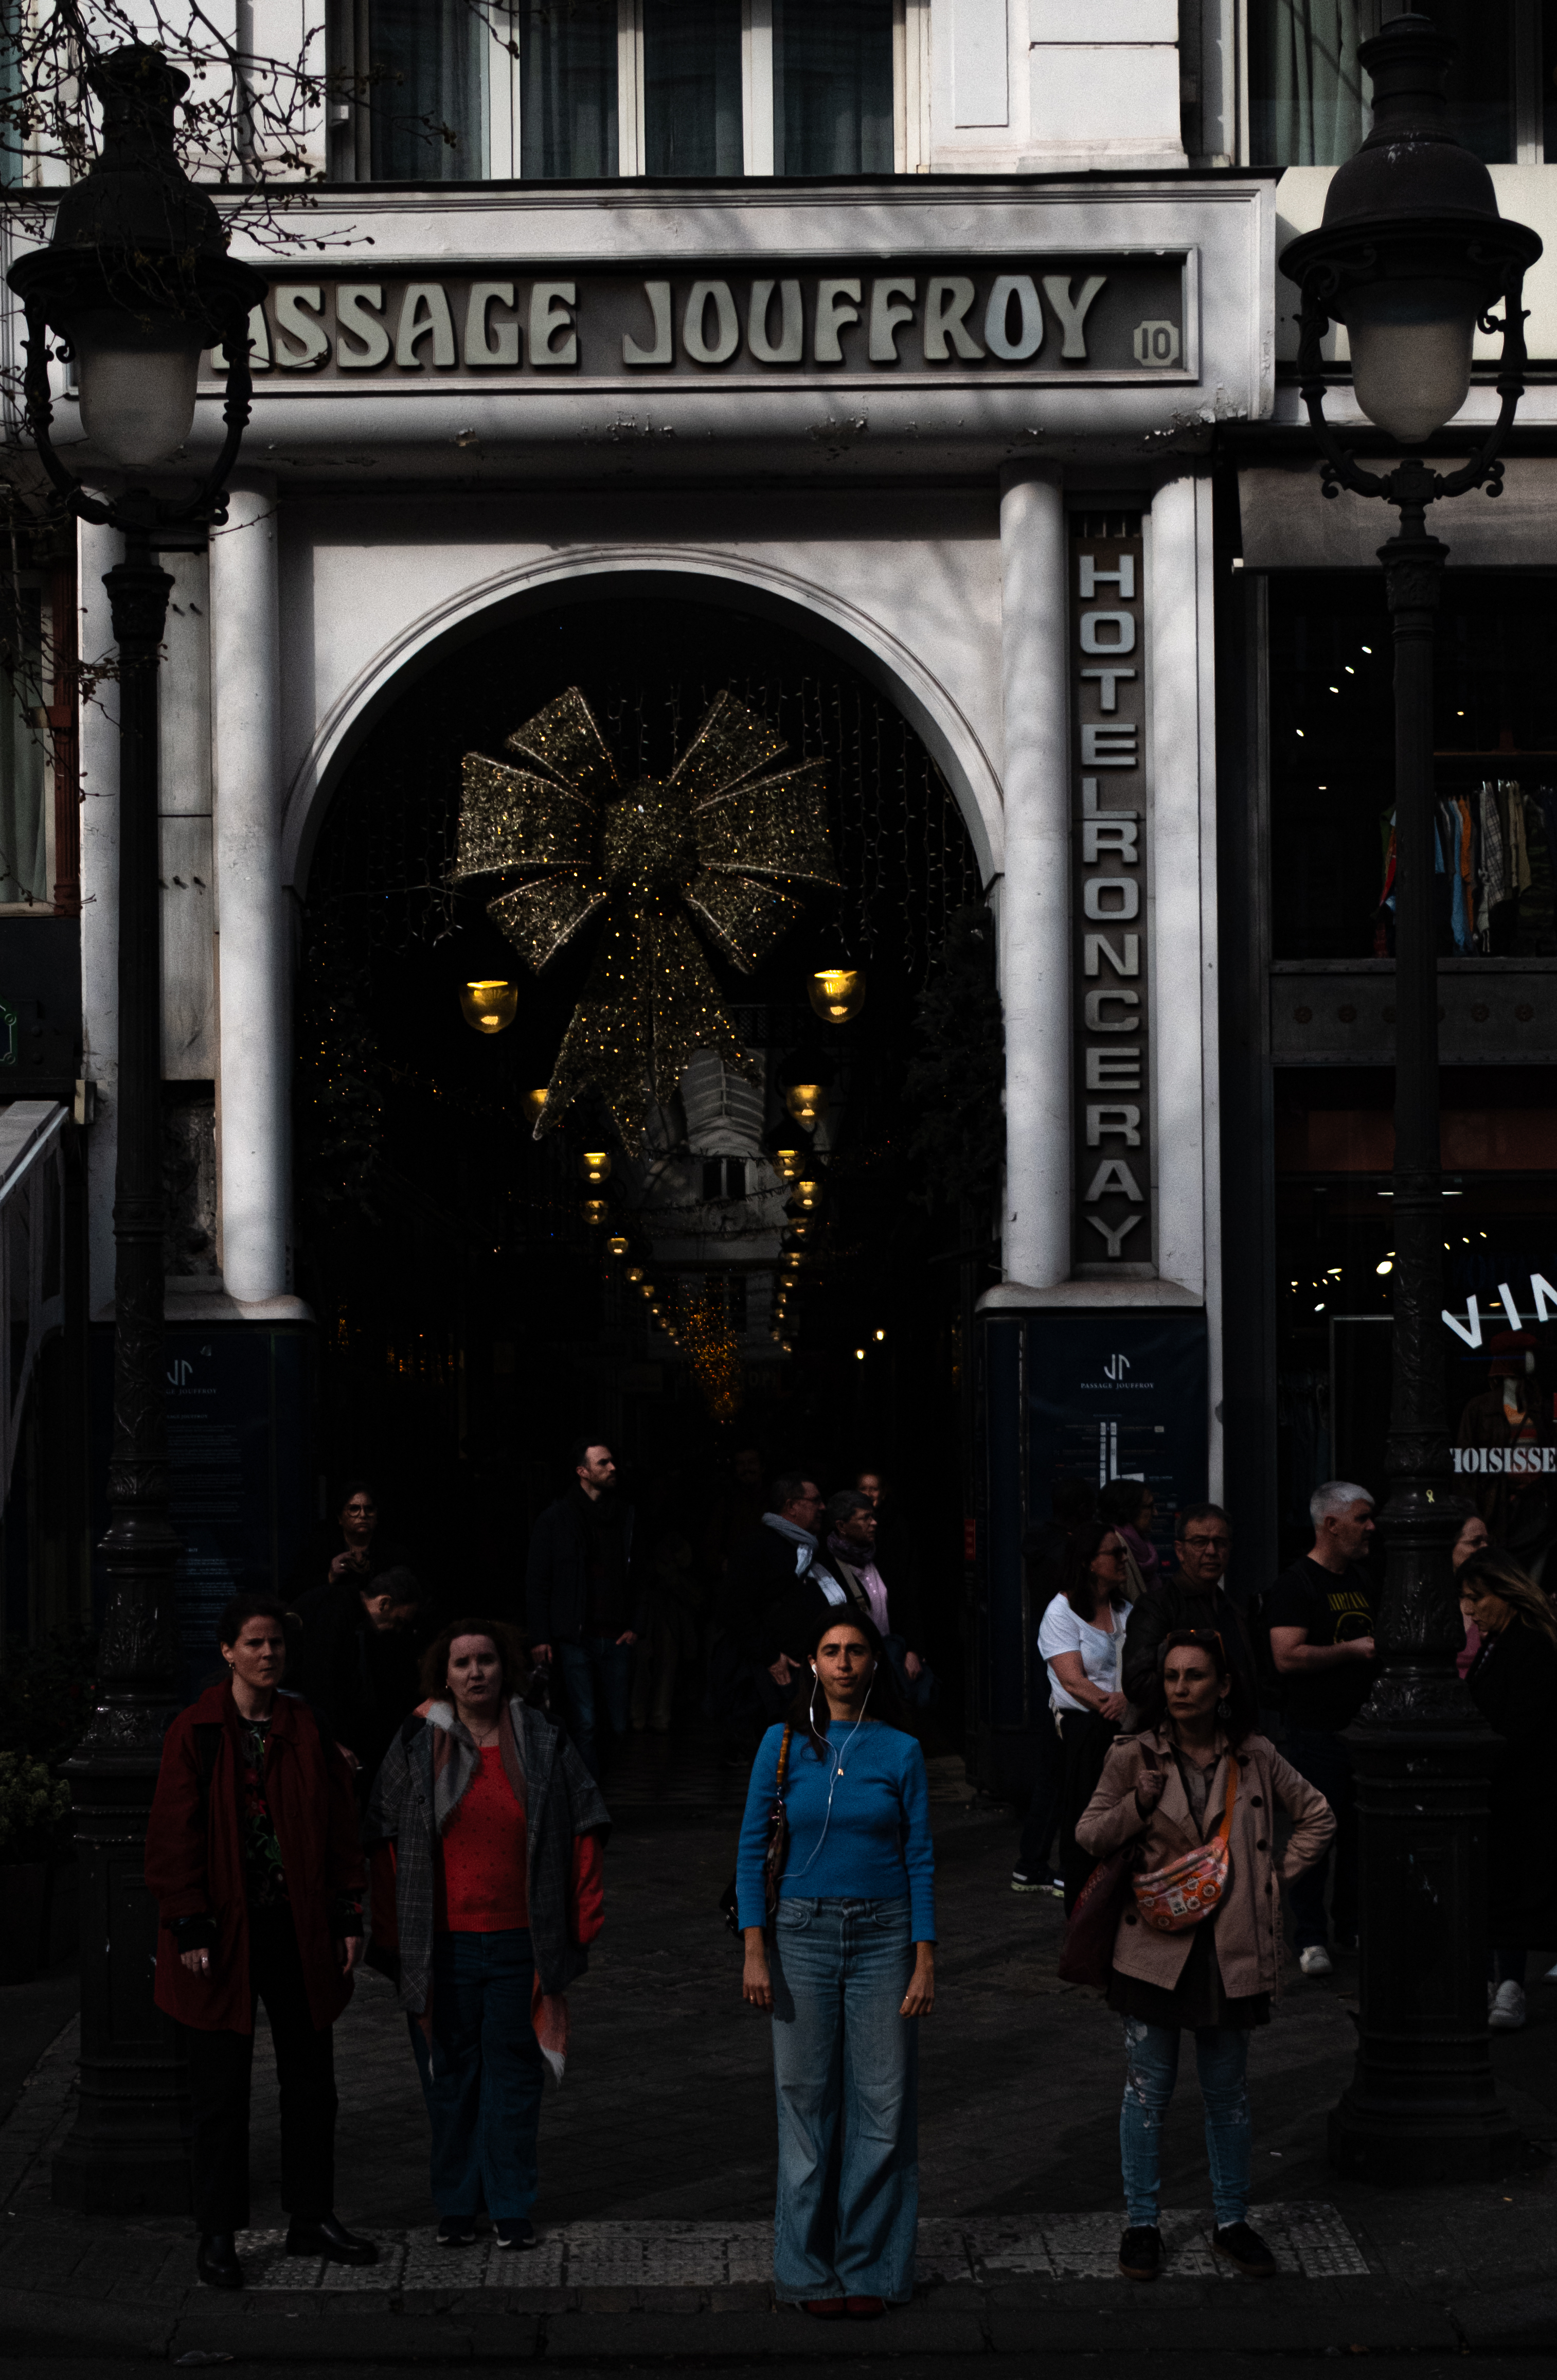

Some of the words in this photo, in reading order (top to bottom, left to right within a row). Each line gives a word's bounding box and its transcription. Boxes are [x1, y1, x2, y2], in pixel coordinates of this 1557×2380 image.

[211, 282, 578, 368] ASSAGE
[623, 275, 1107, 364] JOUFFROY
[1141, 328, 1172, 360] 10
[1079, 554, 1139, 819] HOTEL
[1082, 820, 1145, 1258] RONCERAY
